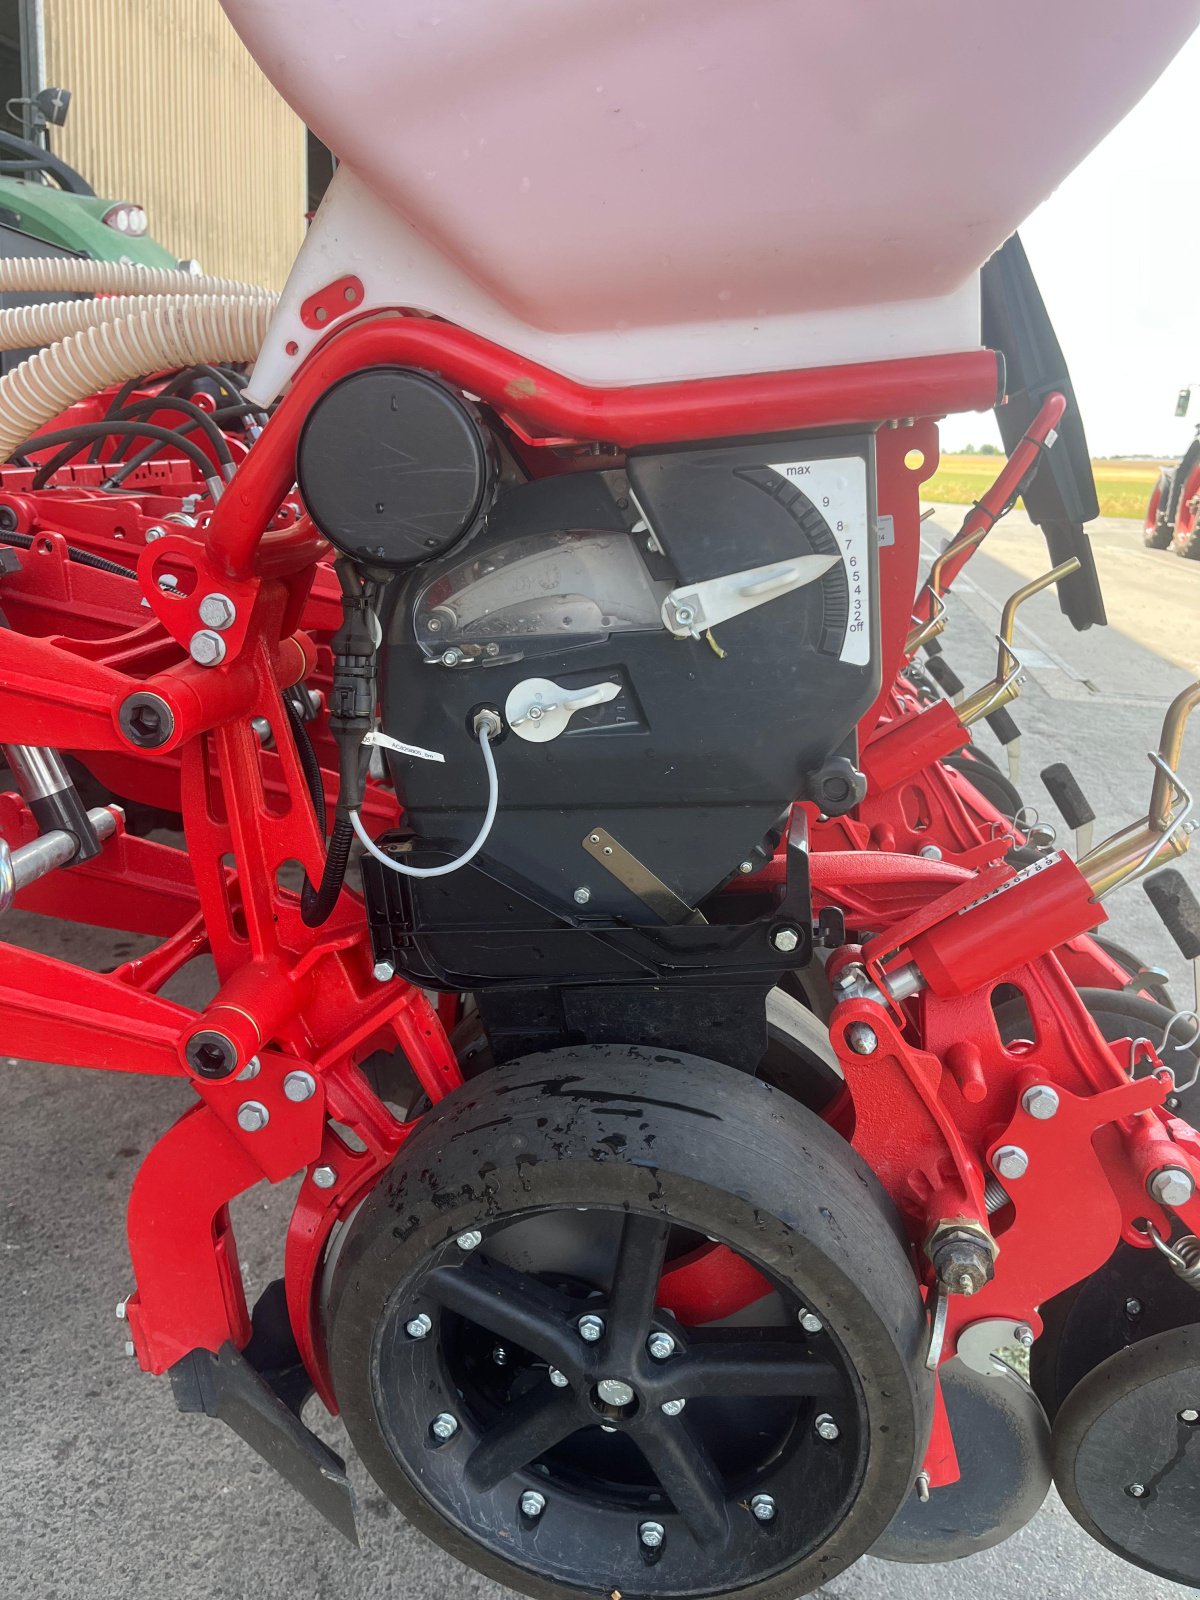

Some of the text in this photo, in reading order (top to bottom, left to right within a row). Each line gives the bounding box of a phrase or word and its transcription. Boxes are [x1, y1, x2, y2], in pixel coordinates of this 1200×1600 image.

[787, 466, 811, 476] max
[822, 497, 830, 507] 9
[836, 521, 844, 531] 8
[845, 539, 852, 550] 7
[849, 556, 857, 567] 6
[852, 571, 860, 582] 5
[854, 585, 861, 595] 4
[854, 599, 861, 609] 3
[854, 611, 861, 621] 2
[849, 621, 864, 632] off
